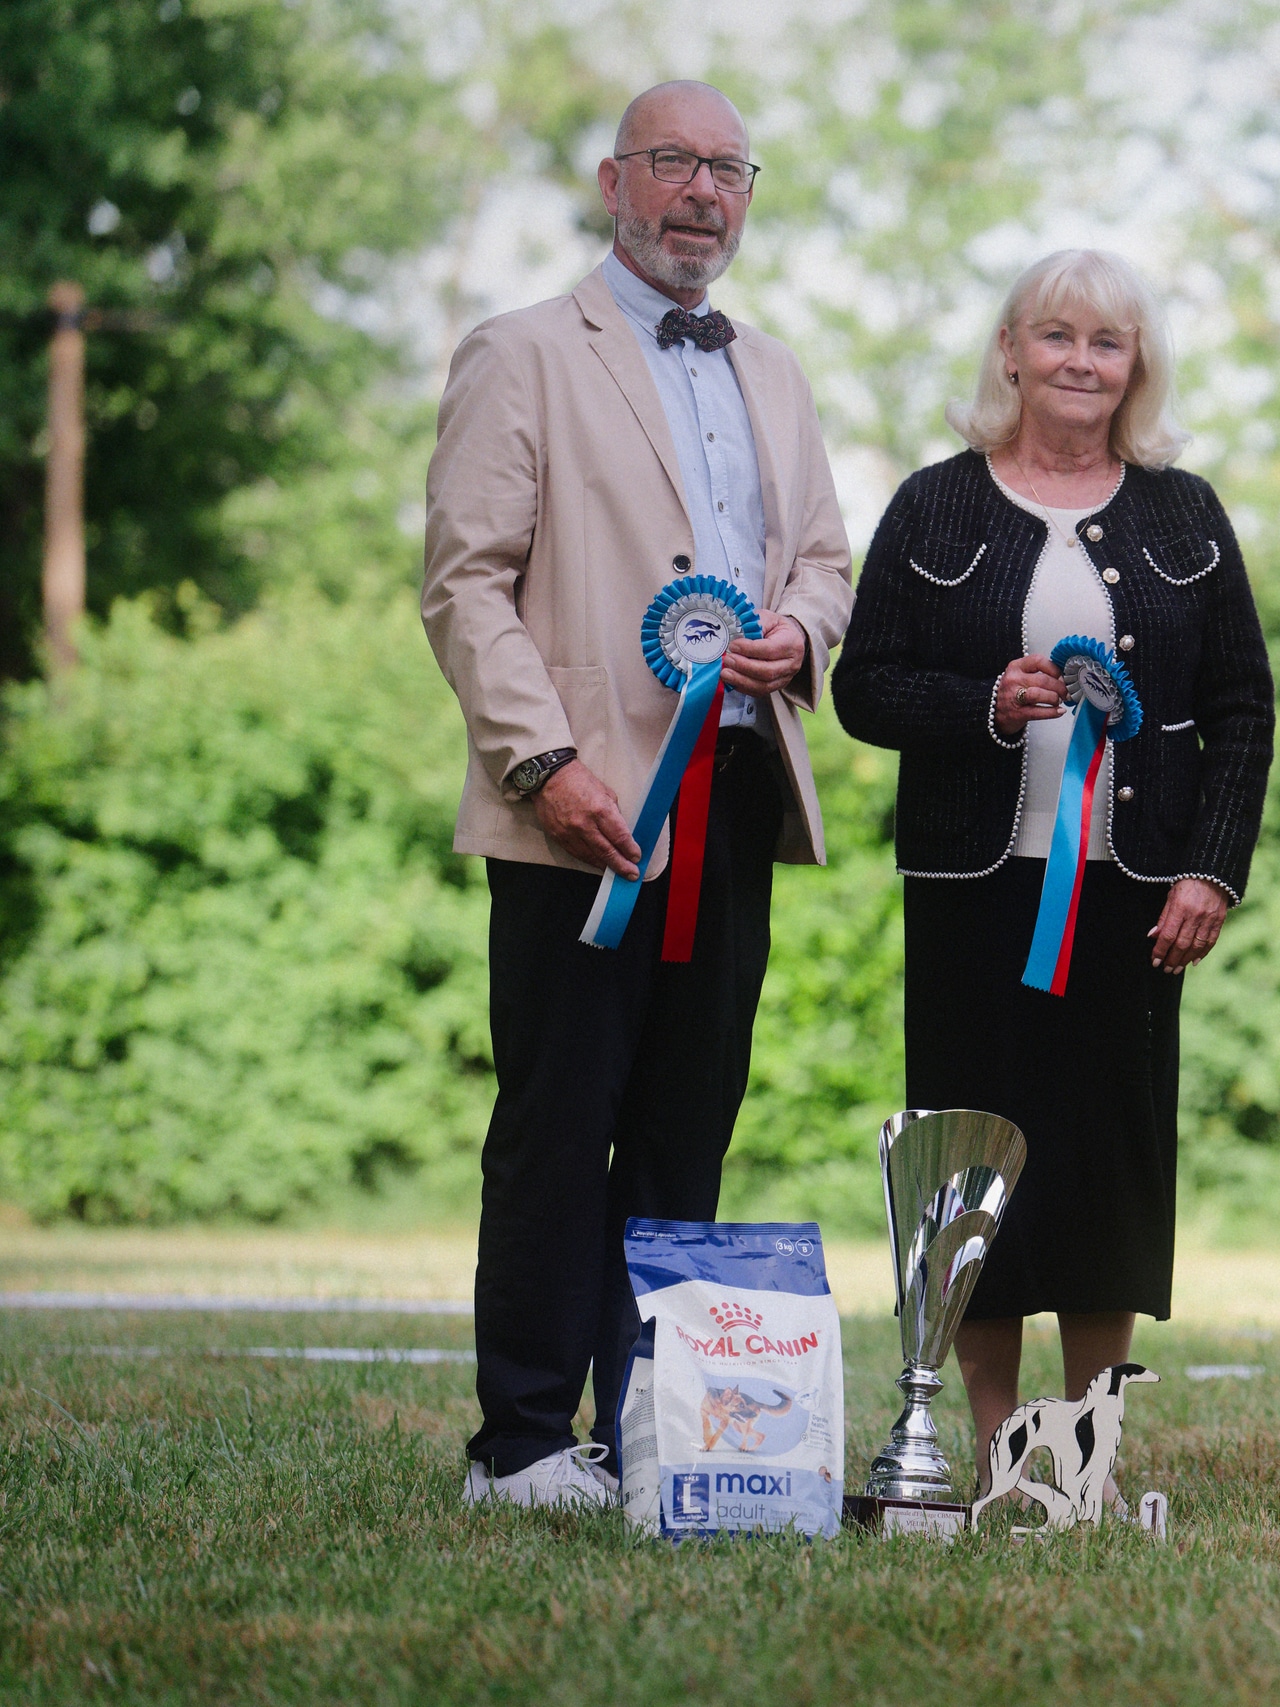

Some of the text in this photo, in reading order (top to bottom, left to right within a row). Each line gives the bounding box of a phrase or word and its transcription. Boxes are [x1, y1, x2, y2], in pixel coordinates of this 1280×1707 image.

[777, 1242, 793, 1252] 3 kg
[675, 1325, 819, 1358] ROYAL CANIN
[715, 1471, 792, 1497] maxi
[682, 1483, 702, 1514] L
[716, 1503, 766, 1520] adult
